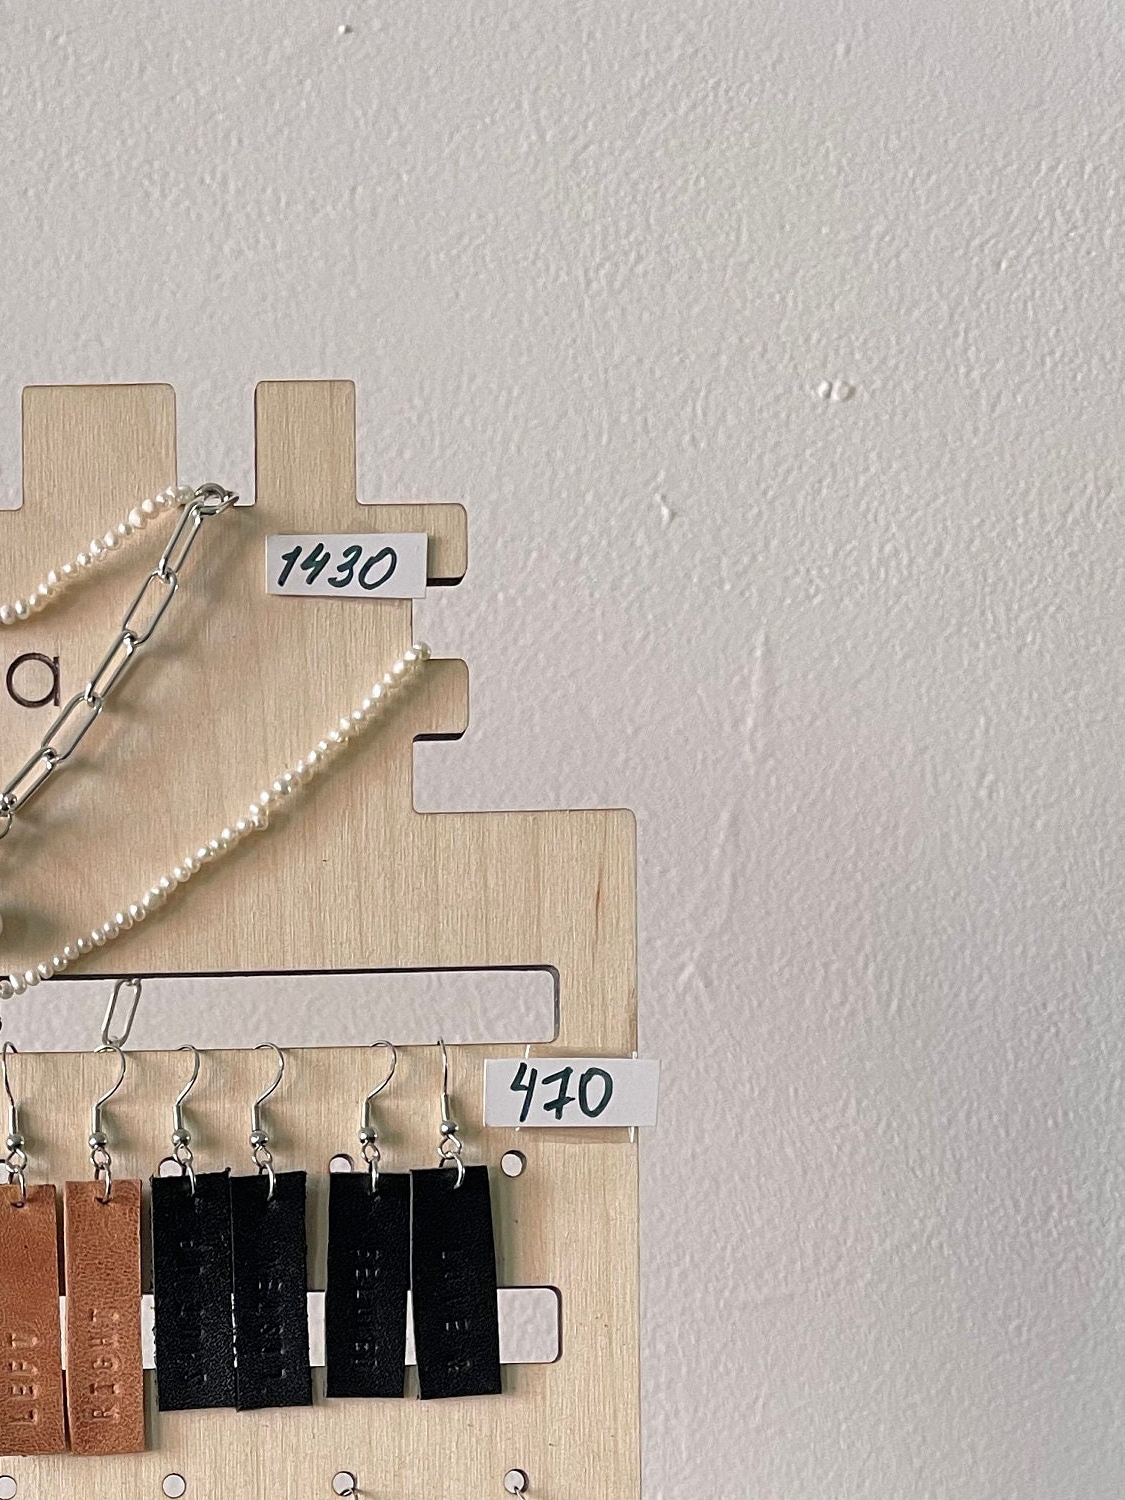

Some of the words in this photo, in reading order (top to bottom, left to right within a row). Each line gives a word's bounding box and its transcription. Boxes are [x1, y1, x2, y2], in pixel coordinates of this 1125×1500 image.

[277, 542, 397, 590] 1430
[510, 1062, 614, 1123] 470
[7, 1333, 38, 1426] LEFT
[88, 1308, 120, 1424] RIGHT
